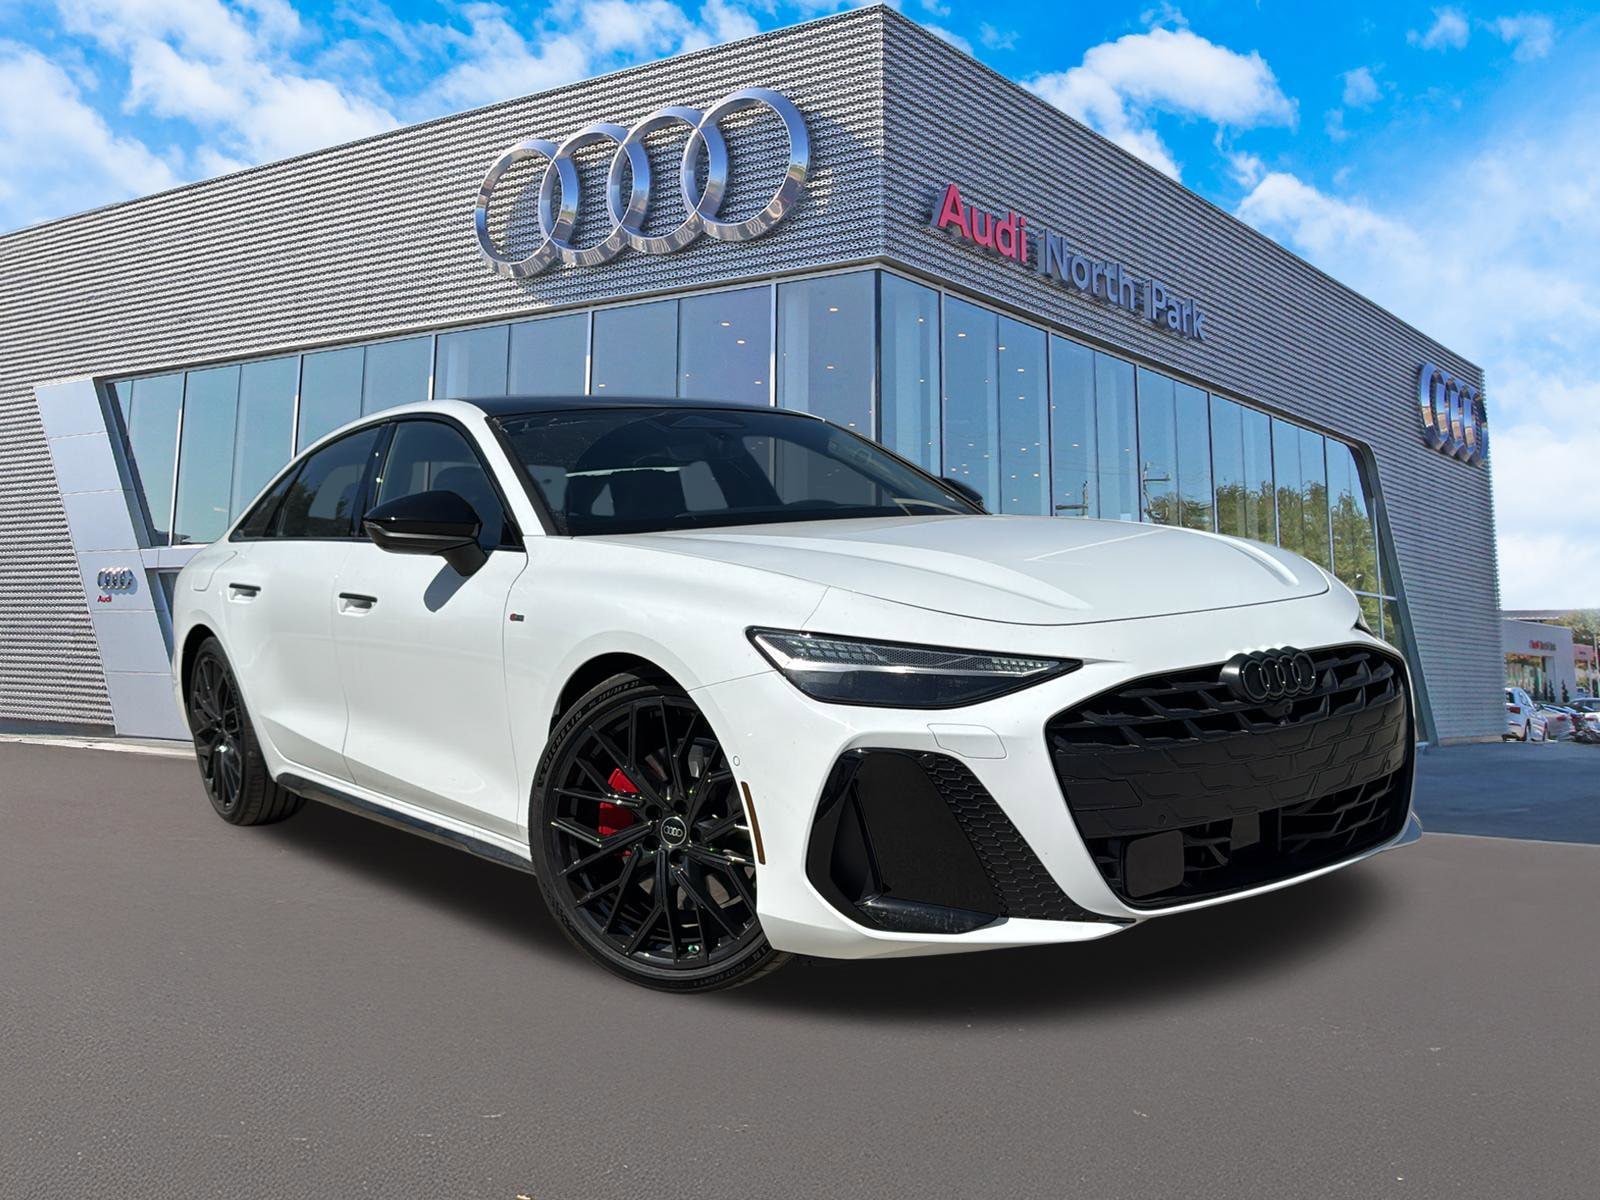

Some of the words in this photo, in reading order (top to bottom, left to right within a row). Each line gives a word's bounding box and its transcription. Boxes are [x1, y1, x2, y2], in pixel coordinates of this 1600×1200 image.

[934, 183, 1027, 264] Audi
[1038, 229, 1136, 311] North
[1145, 279, 1206, 340] Park
[97, 595, 112, 603] Audi
